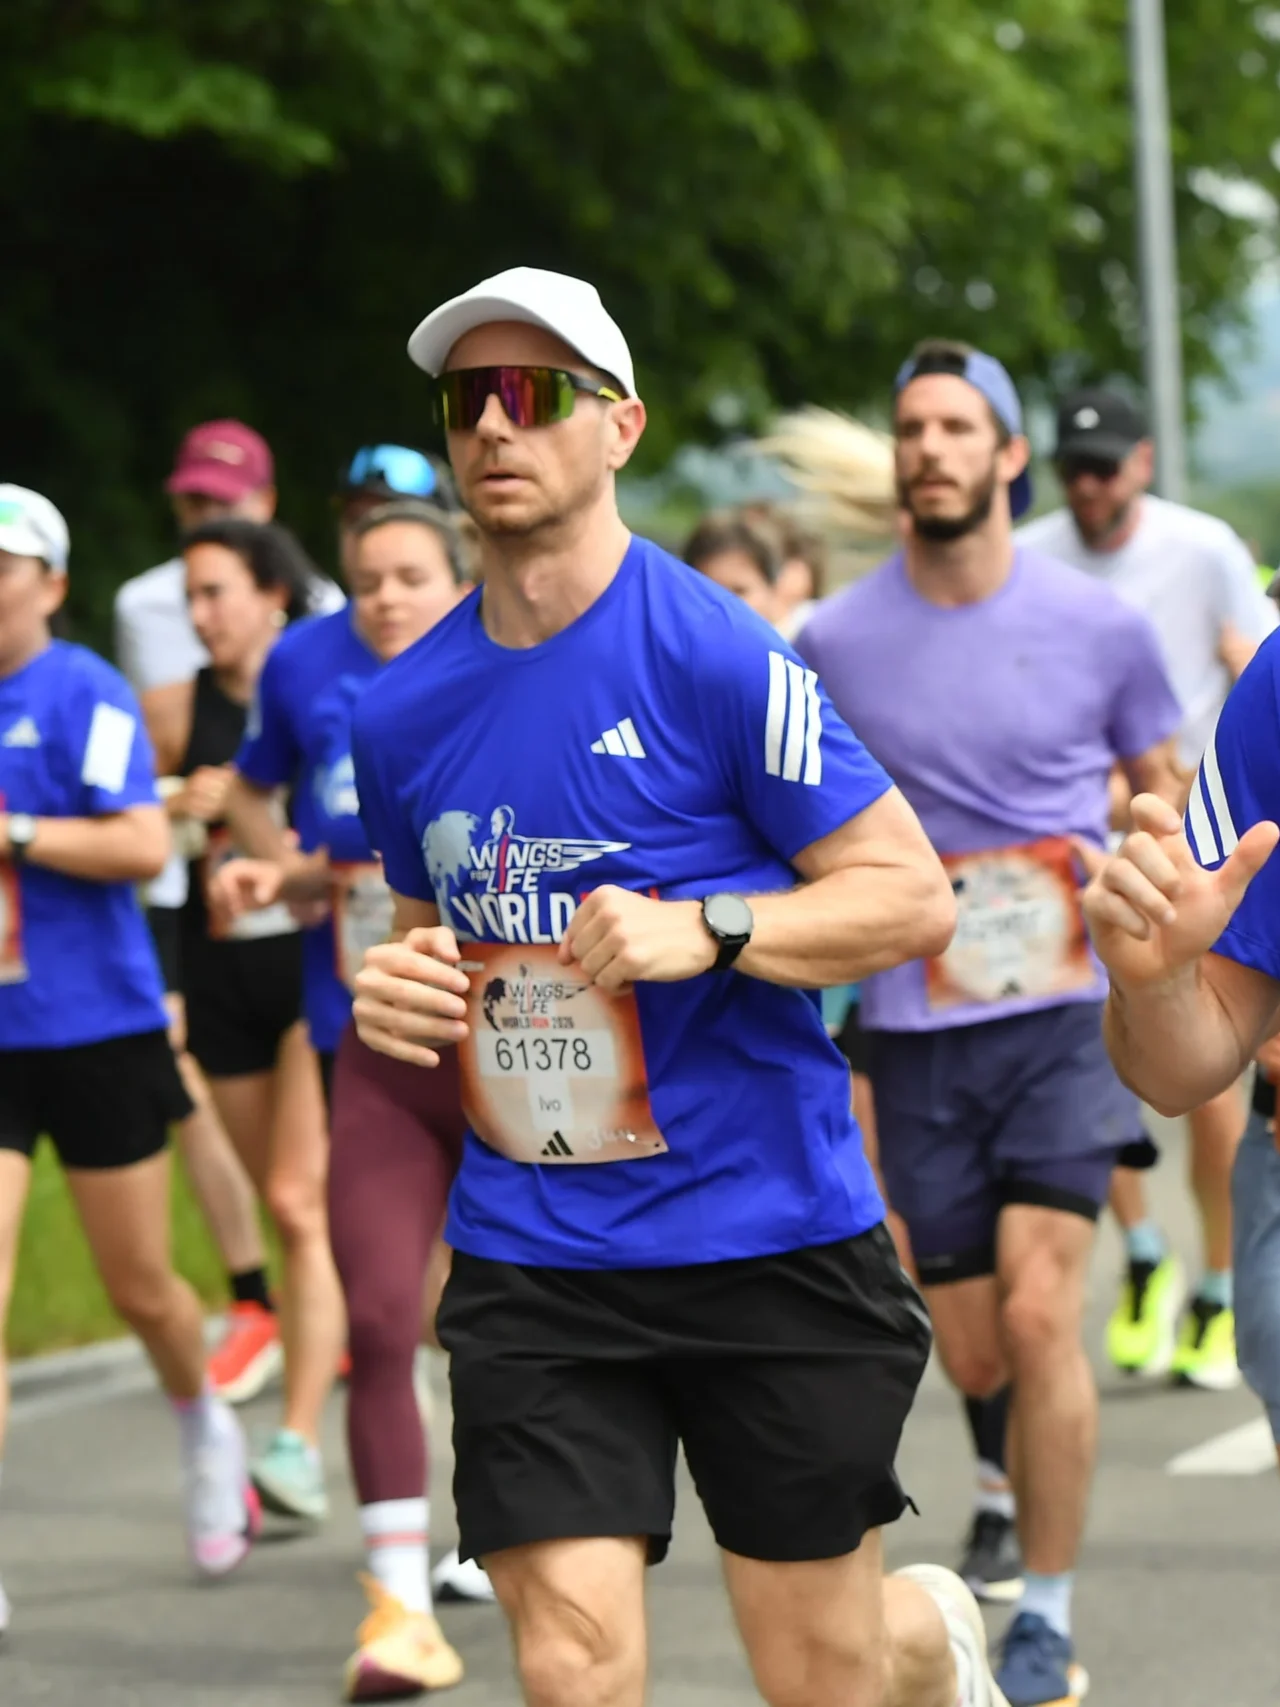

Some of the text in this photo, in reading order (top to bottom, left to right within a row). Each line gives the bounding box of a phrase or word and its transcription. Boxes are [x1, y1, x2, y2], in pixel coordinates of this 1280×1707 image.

[469, 842, 563, 870] WINGS
[486, 868, 541, 893] LIFE
[508, 982, 564, 1000] WINGS
[518, 998, 549, 1015] LIFE
[495, 1037, 592, 1071] 61378
